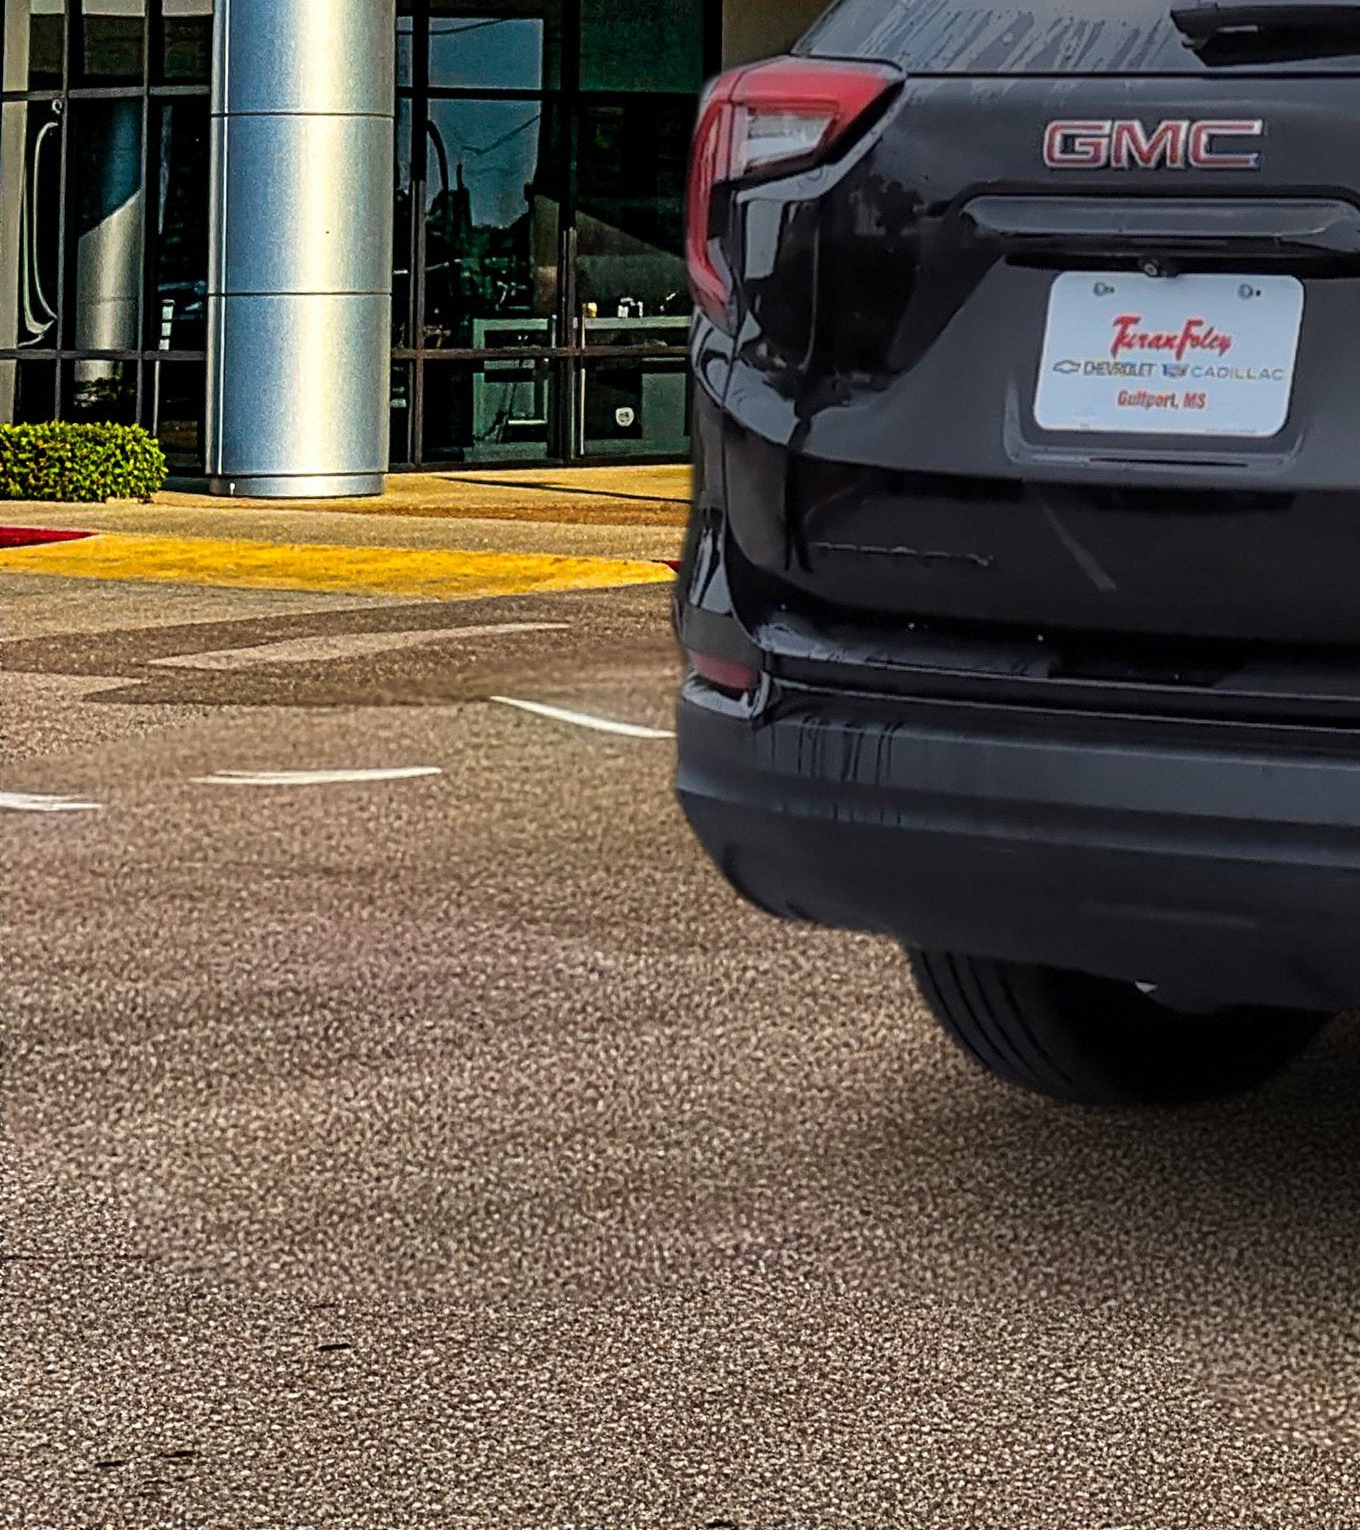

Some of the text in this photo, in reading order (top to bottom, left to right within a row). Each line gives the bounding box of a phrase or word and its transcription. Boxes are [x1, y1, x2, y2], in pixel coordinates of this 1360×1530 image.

[1043, 119, 1264, 170] GMC
[1191, 366, 1285, 381] CADILLAC
[1183, 390, 1207, 410] MS
